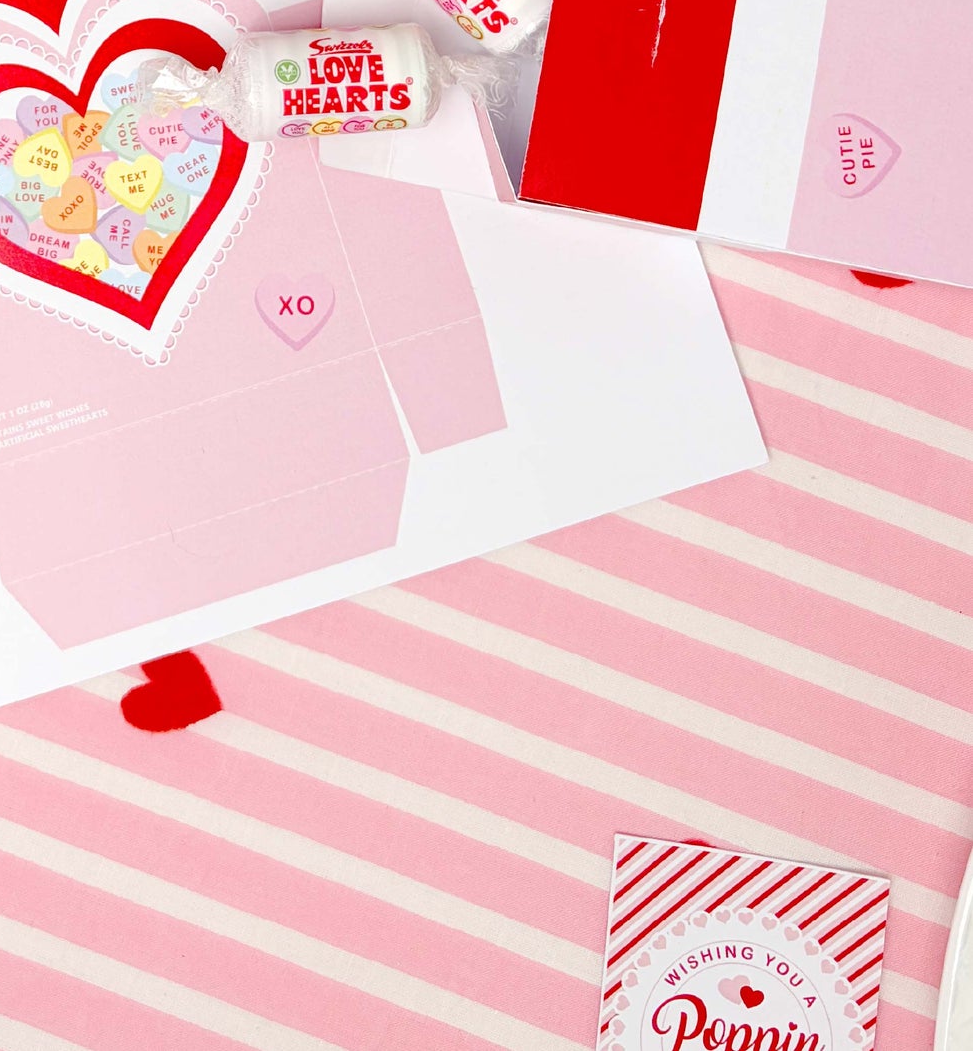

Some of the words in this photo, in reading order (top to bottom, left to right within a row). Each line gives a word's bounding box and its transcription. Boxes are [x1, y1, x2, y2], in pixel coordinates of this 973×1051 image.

[307, 54, 385, 85] LOVE
[283, 83, 411, 117] HEARTS
[34, 104, 58, 115] FOR
[35, 117, 59, 127] YOU
[73, 122, 87, 138] ME
[148, 123, 184, 136] CUTIE
[77, 122, 103, 151] SPOIL
[116, 122, 129, 147] YOU
[128, 121, 142, 151] LOVE
[158, 136, 178, 147] PIE
[36, 145, 59, 159] DAY
[838, 125, 857, 186] CUTIE
[860, 137, 876, 169] PIE
[28, 155, 59, 172] BEST
[177, 153, 208, 175] DEAR
[80, 169, 107, 195] TRUE
[119, 170, 148, 184] TEXT
[186, 165, 210, 183] ONE
[20, 181, 41, 191] BIG
[128, 184, 145, 194] ME
[15, 193, 45, 203] LOVE
[150, 193, 175, 212] HUG
[58, 195, 84, 221] XOXO
[160, 206, 177, 221] ME
[29, 233, 71, 250] DREAM
[109, 224, 118, 242] ME
[120, 219, 132, 250] CALL
[37, 247, 58, 259] BIG
[147, 245, 164, 255] ME
[279, 295, 315, 316] XO
[26, 413, 54, 430] SWEET
[55, 402, 90, 419] WISHES
[45, 408, 109, 435] SWEETHEARTS
[664, 944, 754, 987] WISHING
[765, 953, 804, 987] YOU
[803, 996, 817, 1008] A
